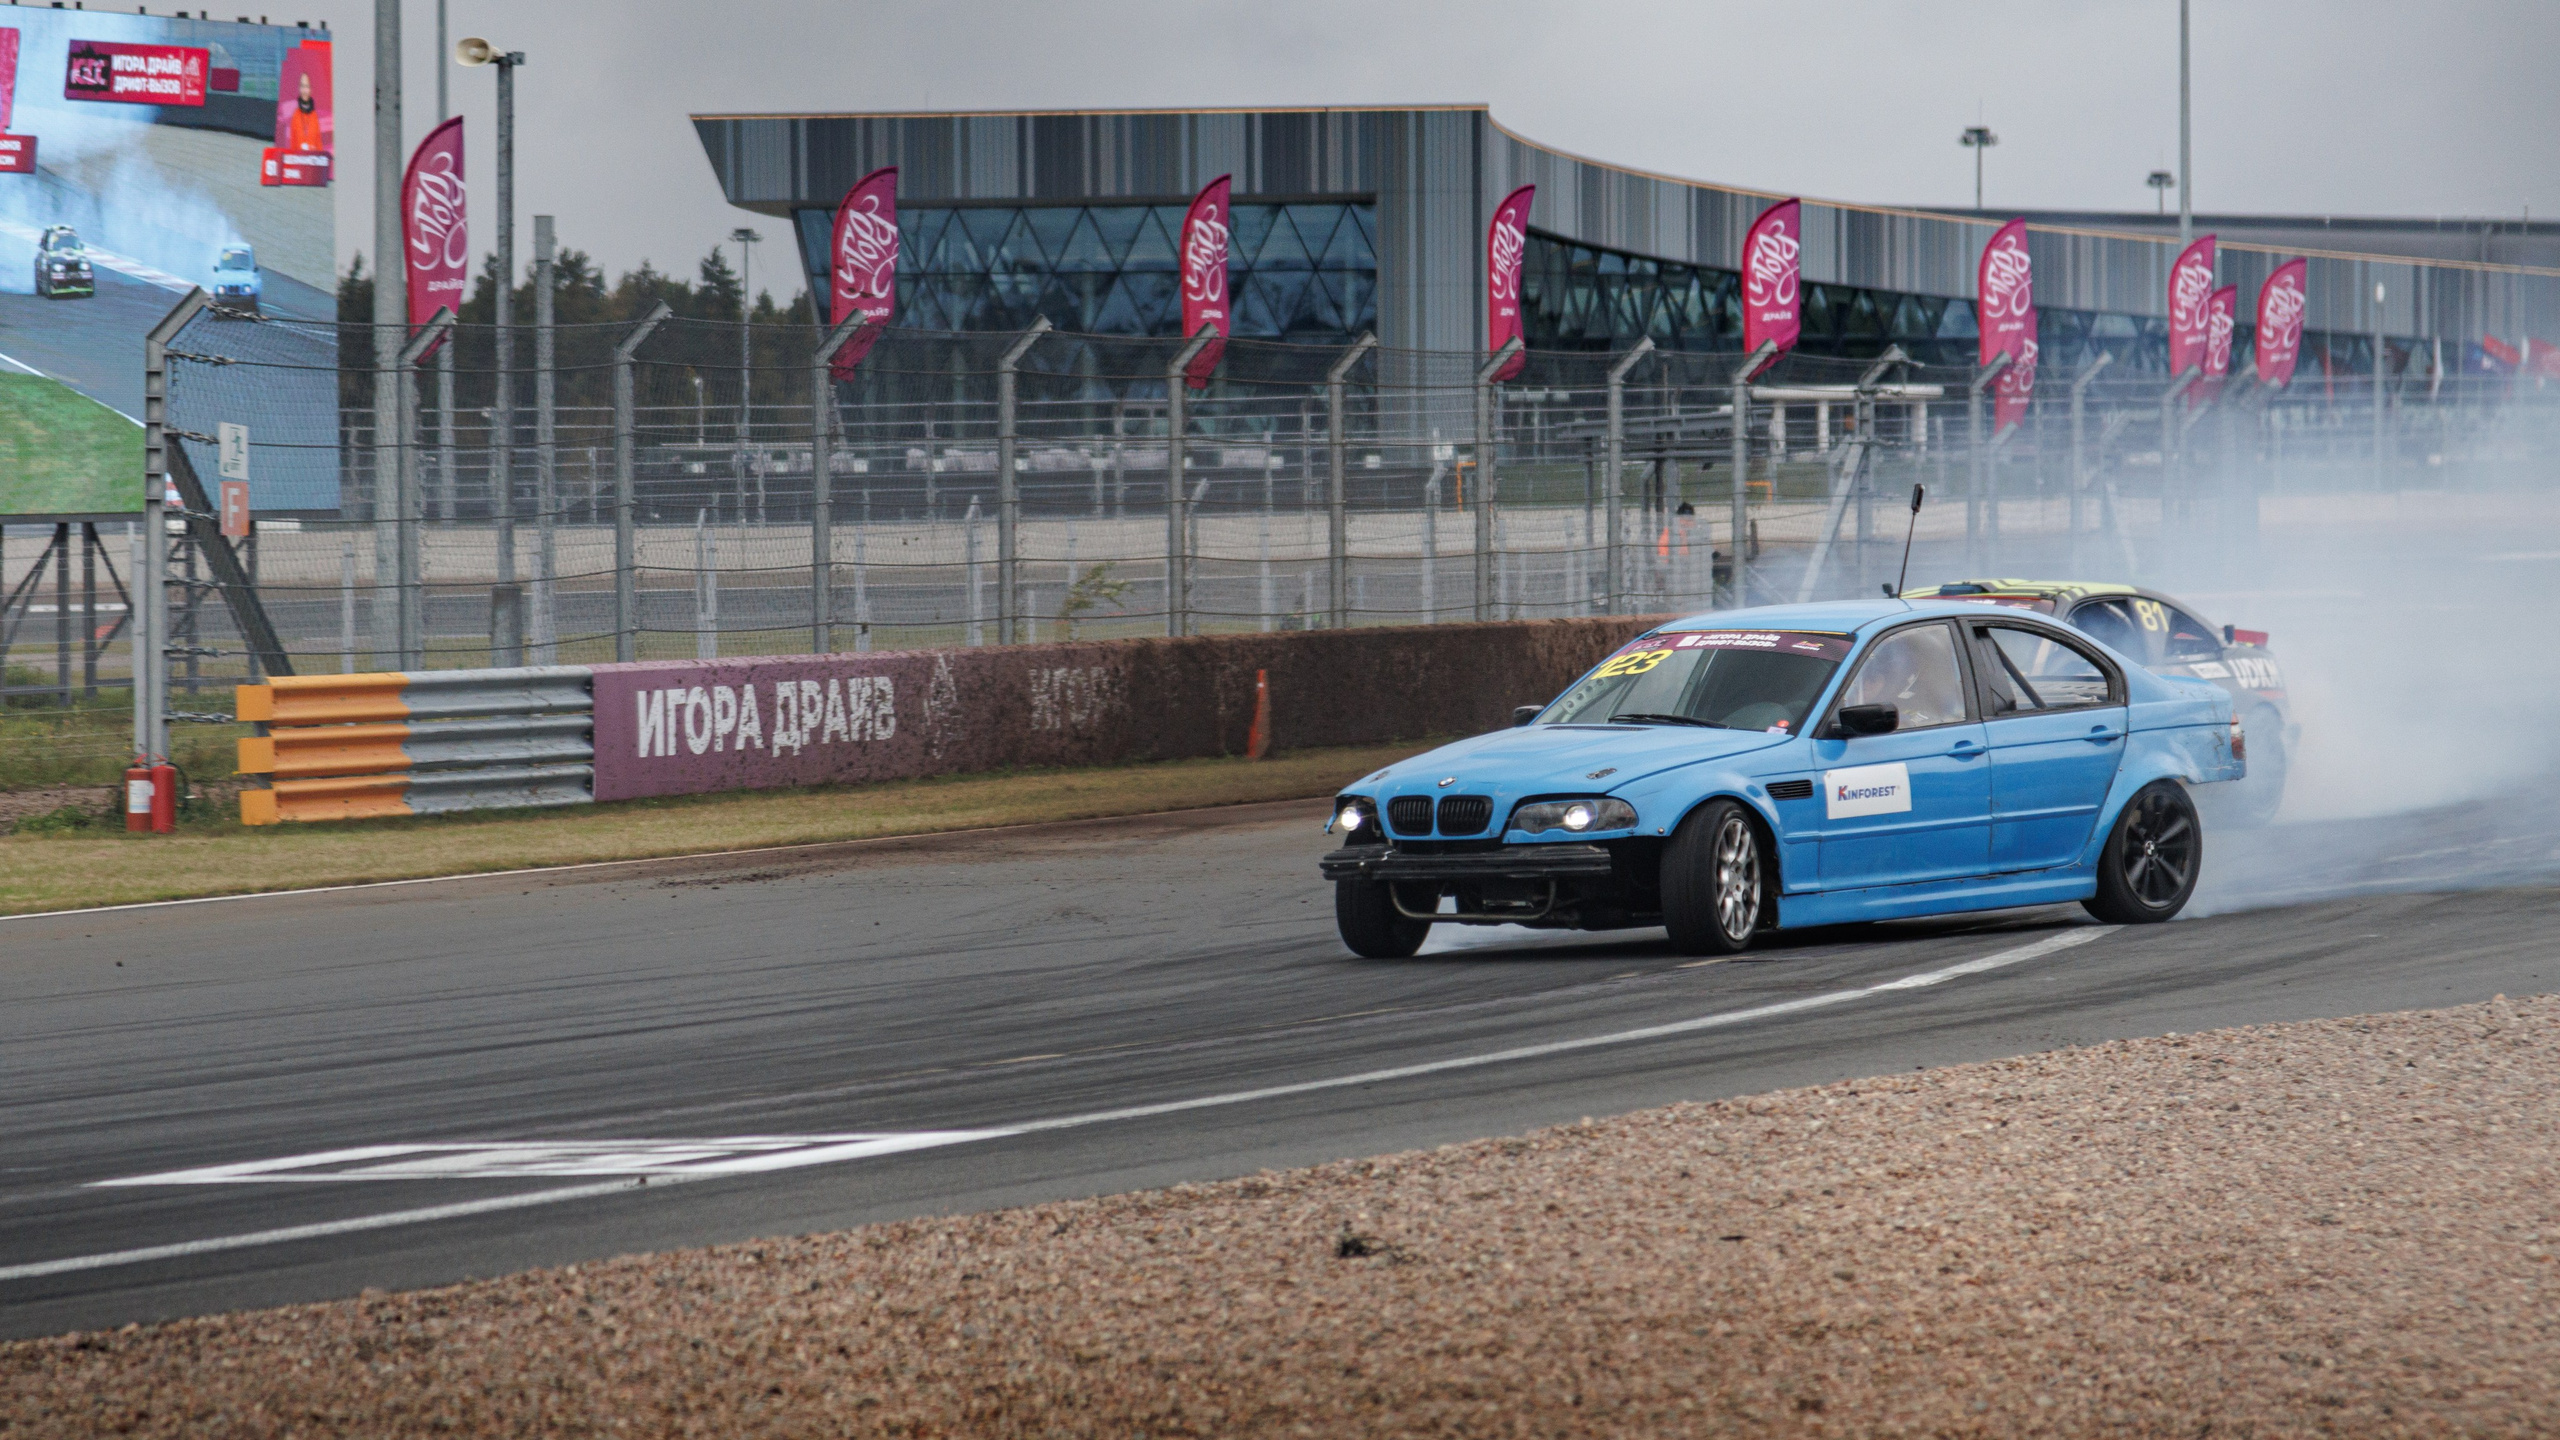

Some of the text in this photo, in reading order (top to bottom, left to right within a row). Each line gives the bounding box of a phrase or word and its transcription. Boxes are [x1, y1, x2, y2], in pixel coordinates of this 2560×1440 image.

[111, 54, 147, 73] ИГОРА
[147, 54, 182, 75] ДРАЙВ
[228, 487, 240, 528] F
[2134, 600, 2170, 633] 81
[1590, 649, 1673, 680] 123
[637, 683, 764, 758] ИГОРА
[1838, 785, 1896, 802] KINFOREST
